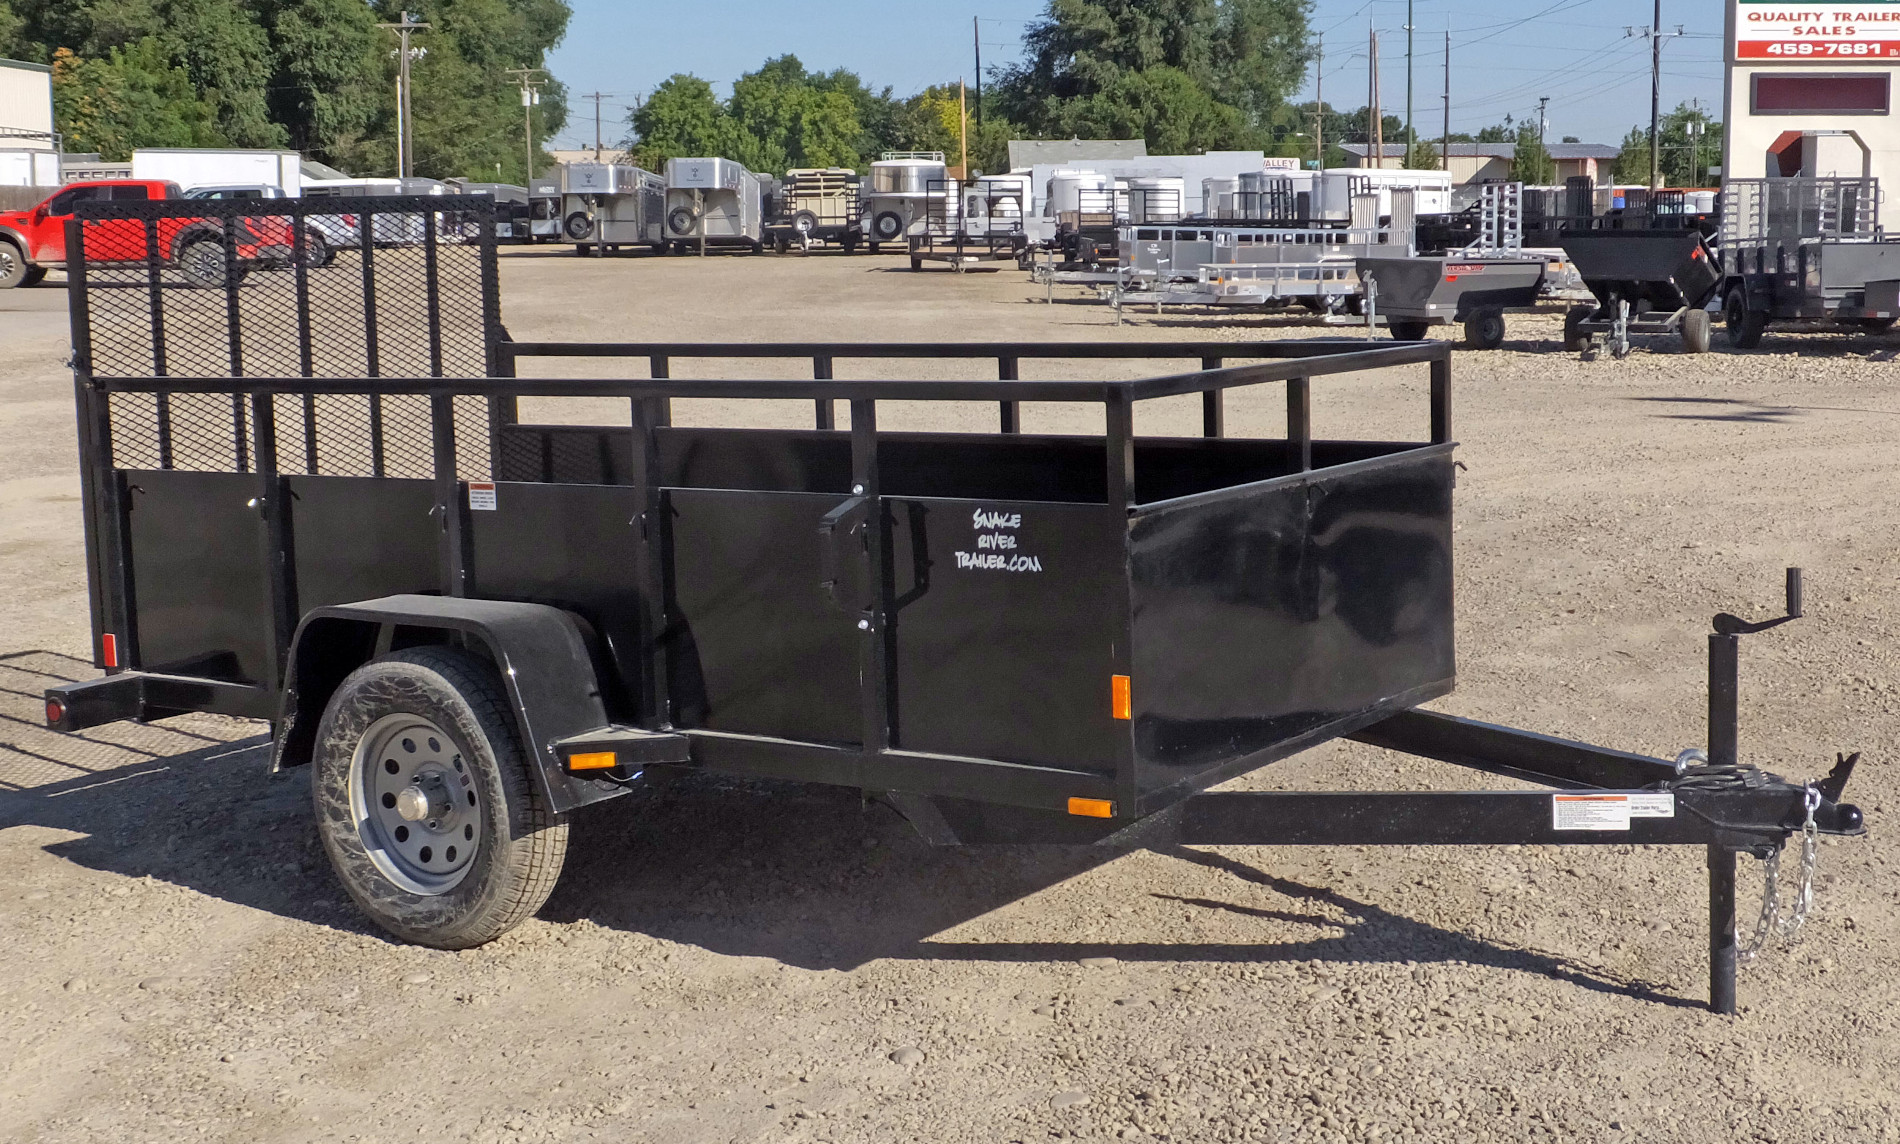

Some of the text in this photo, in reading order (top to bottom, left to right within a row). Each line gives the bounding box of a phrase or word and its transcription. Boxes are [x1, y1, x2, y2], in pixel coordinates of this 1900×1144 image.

[1747, 12, 1900, 22] QUALITY TRAILER
[1793, 26, 1856, 36] SALES
[1767, 43, 1881, 55] 459-7681
[972, 507, 1022, 530] SNAKE
[977, 531, 1018, 551] RIVER
[955, 551, 1043, 573] TRAILER.COM
